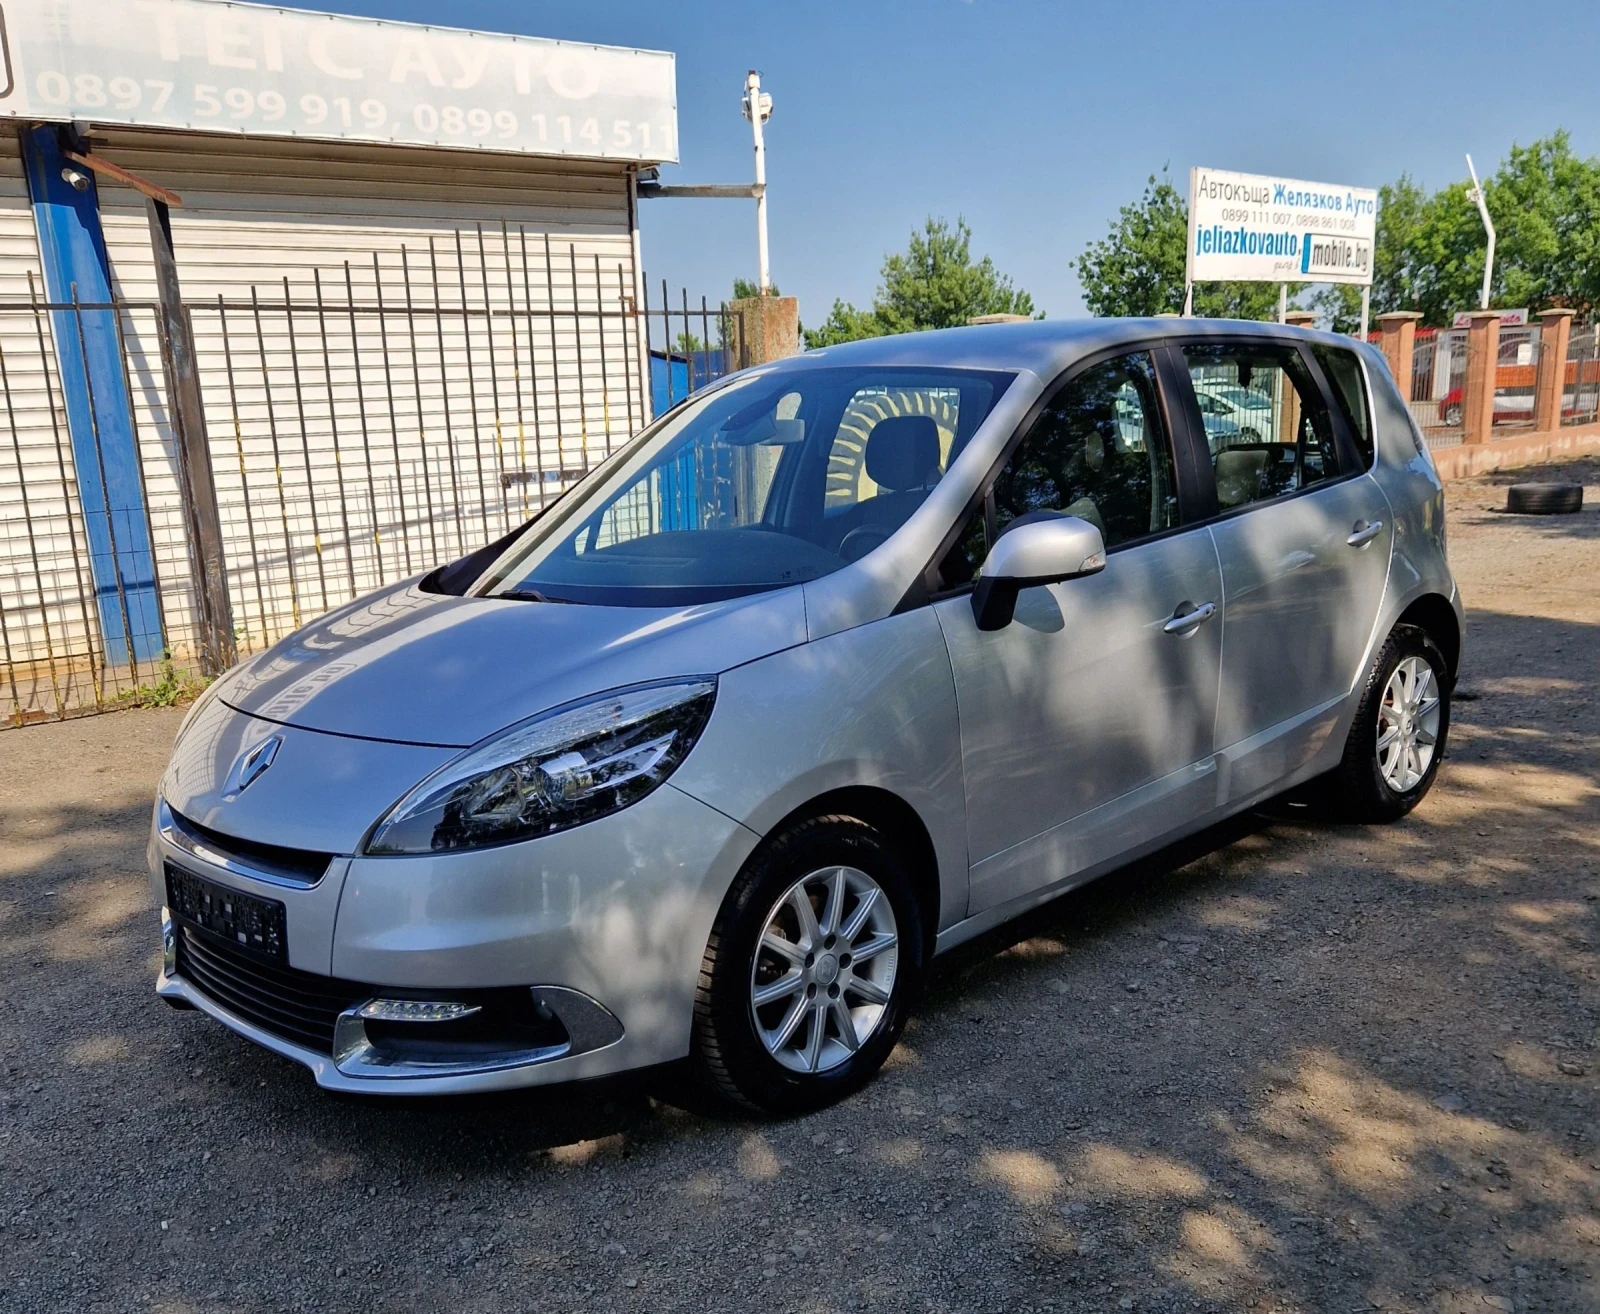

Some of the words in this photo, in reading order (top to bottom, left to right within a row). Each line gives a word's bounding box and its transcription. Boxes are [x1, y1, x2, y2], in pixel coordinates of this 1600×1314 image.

[388, 31, 601, 99] АУТО
[36, 70, 174, 113] 0897
[195, 83, 286, 121] 599
[300, 94, 400, 135] 919,
[413, 103, 519, 139] 0899
[532, 113, 601, 145] 114
[613, 119, 671, 151] 511
[1198, 174, 1270, 208] Автокъща
[1273, 183, 1343, 212] Желязков
[1345, 192, 1374, 217] Ауто
[1221, 208, 1249, 222] 0899
[1252, 210, 1270, 224] 111
[1272, 212, 1294, 227] 007,
[1312, 239, 1368, 272] mobile.bg
